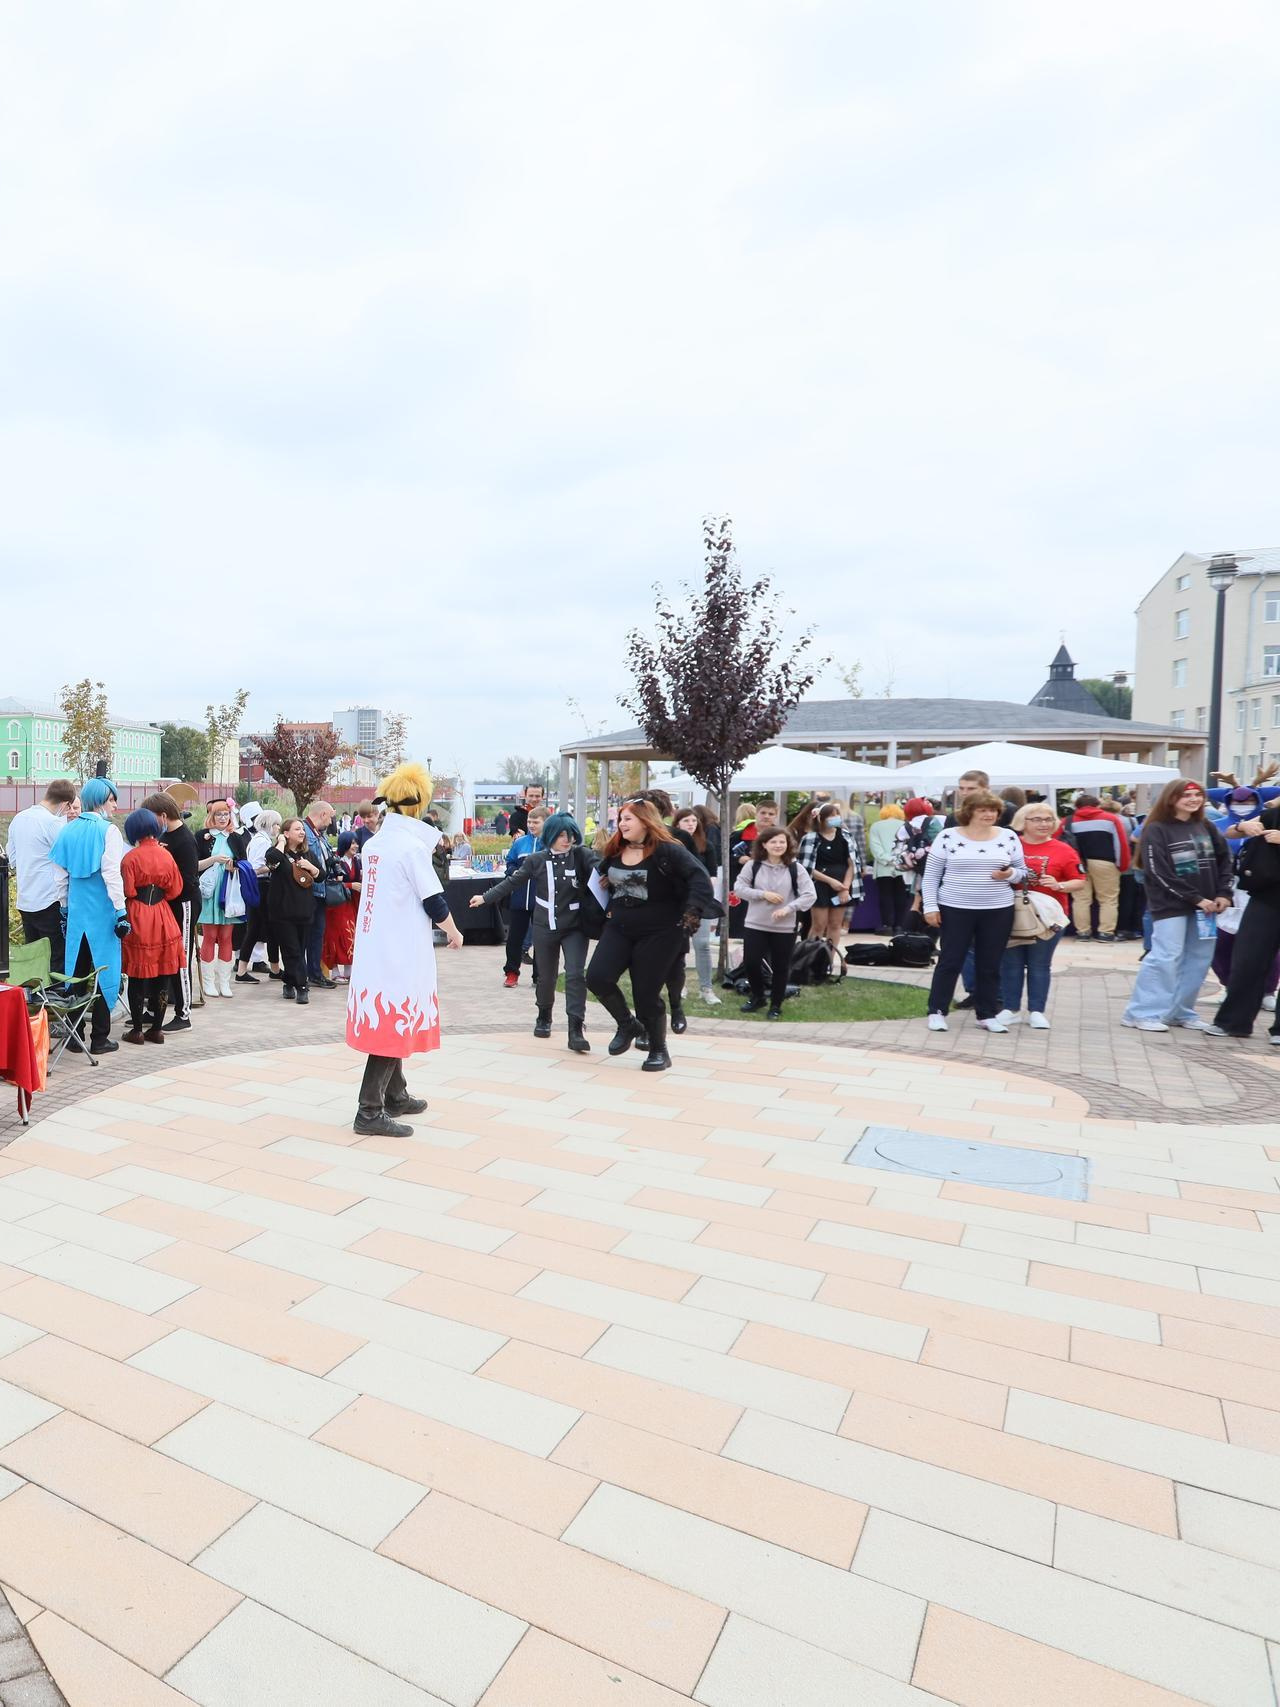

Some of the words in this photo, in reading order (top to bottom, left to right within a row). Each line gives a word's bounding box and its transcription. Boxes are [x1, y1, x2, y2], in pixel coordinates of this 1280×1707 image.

[362, 854, 380, 934] 四代目火影
